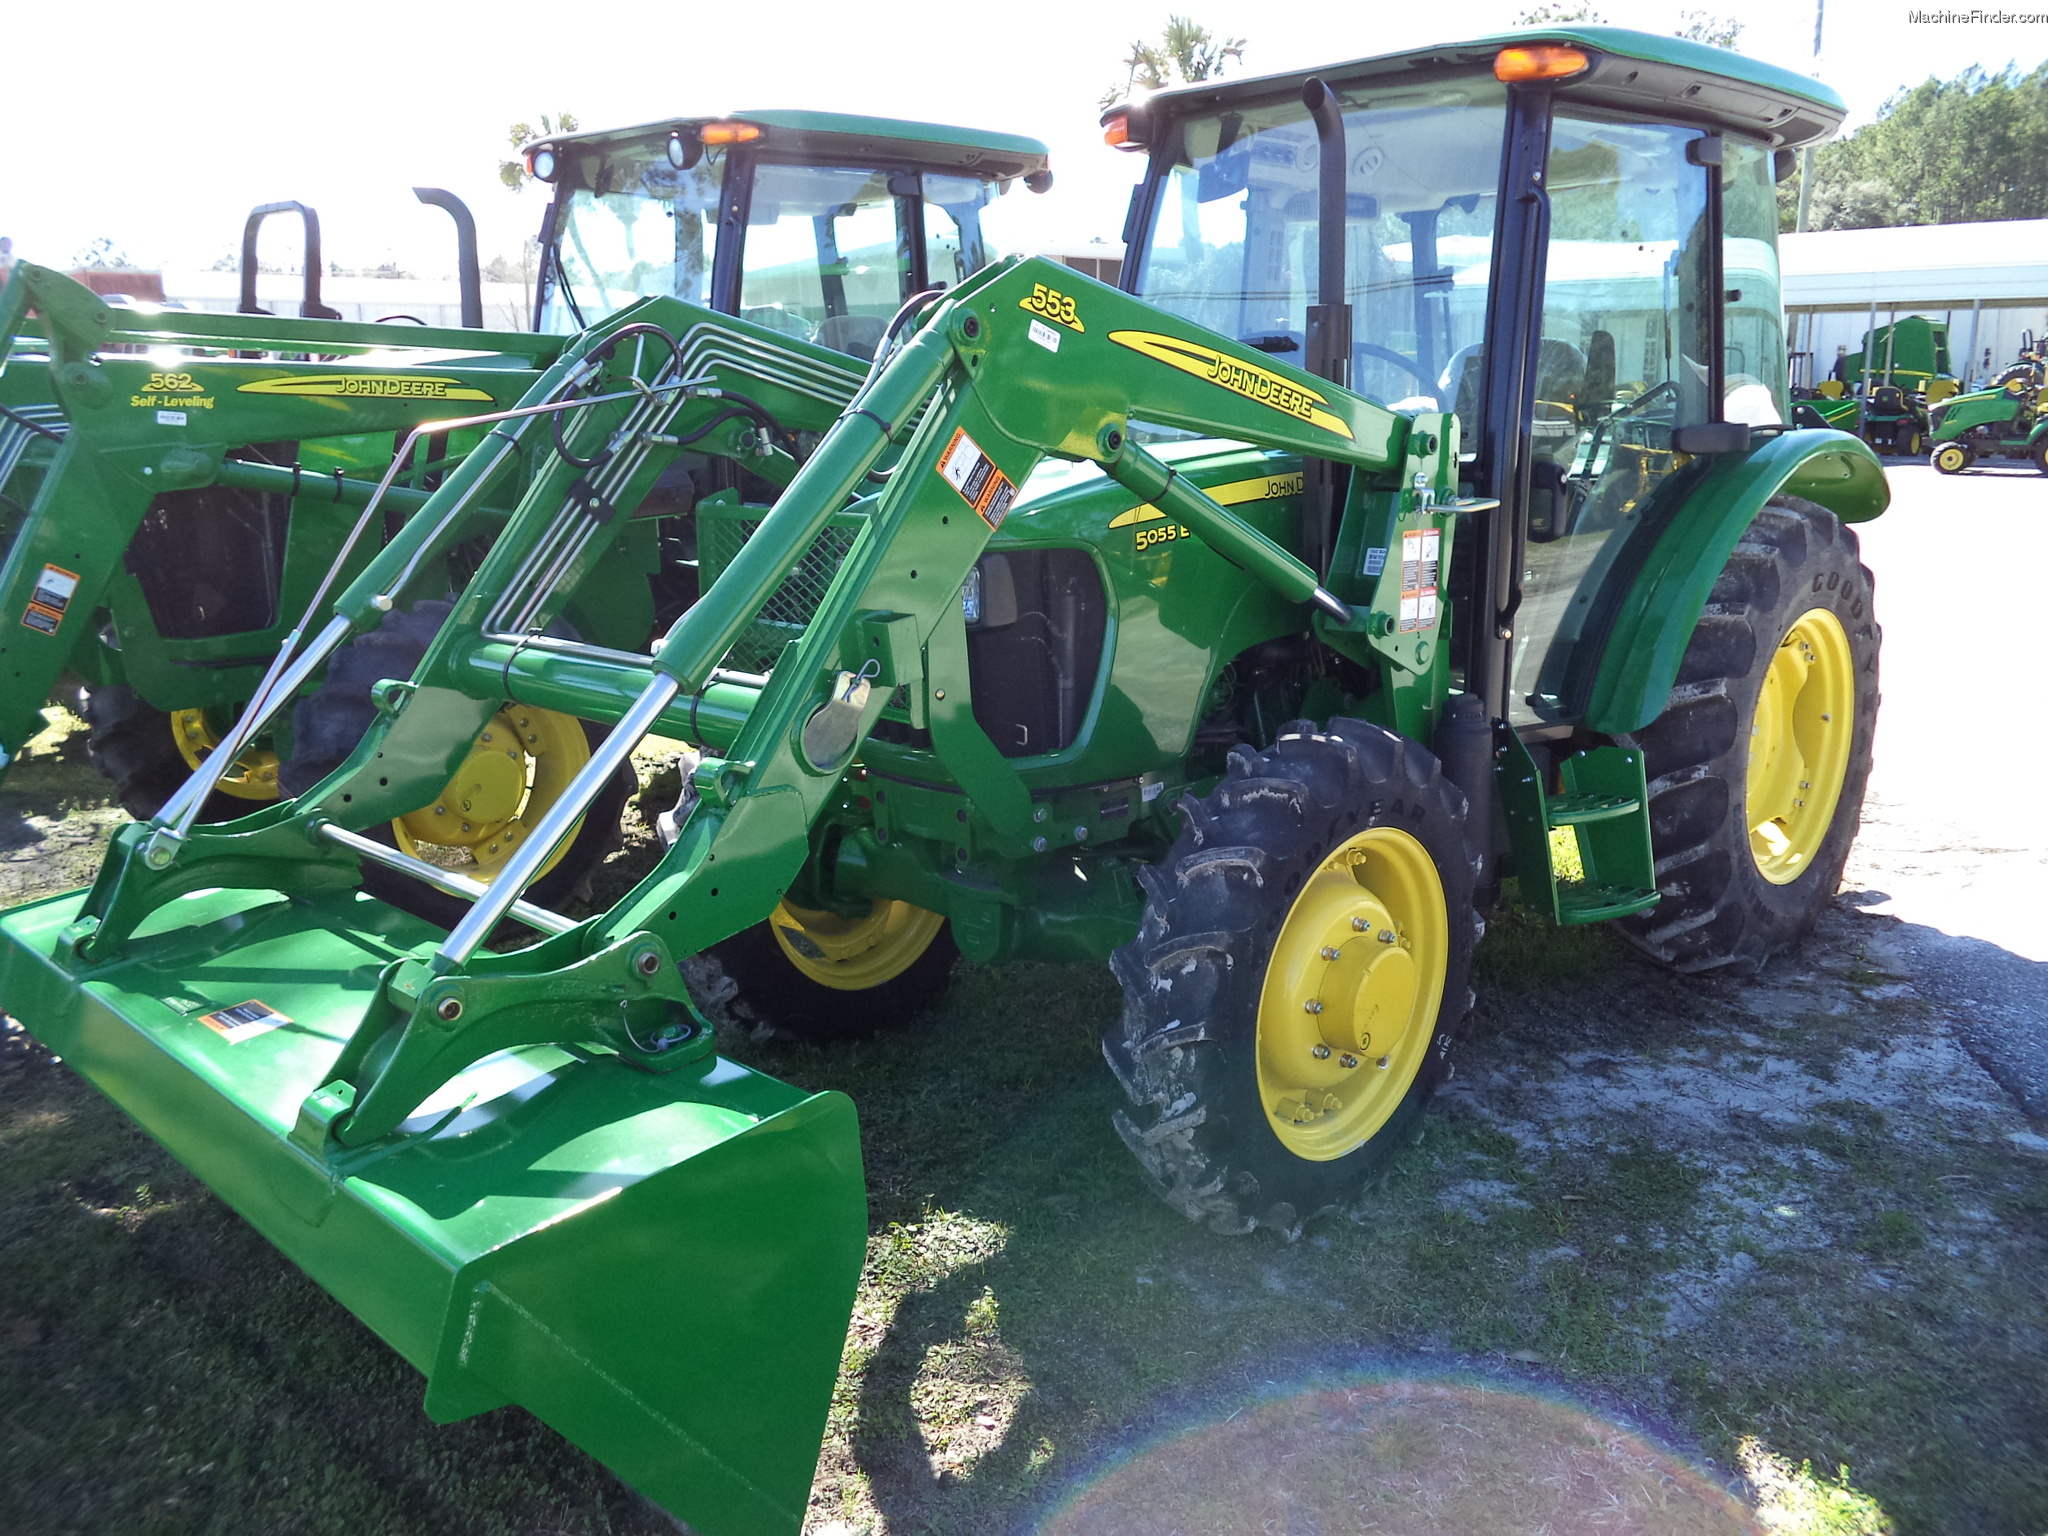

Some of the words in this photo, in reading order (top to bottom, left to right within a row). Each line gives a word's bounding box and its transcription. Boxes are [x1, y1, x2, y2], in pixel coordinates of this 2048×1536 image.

[1031, 281, 1077, 325] 553
[150, 372, 194, 391] 562
[336, 377, 385, 395] JOHN
[386, 377, 447, 397] DEERE
[1207, 355, 1256, 395] JOHN
[1255, 373, 1314, 419] DEERE
[944, 432, 962, 461] WARNING
[984, 475, 1001, 504] WARNING
[1264, 480, 1294, 496] JOHN
[1135, 524, 1177, 551] 5055
